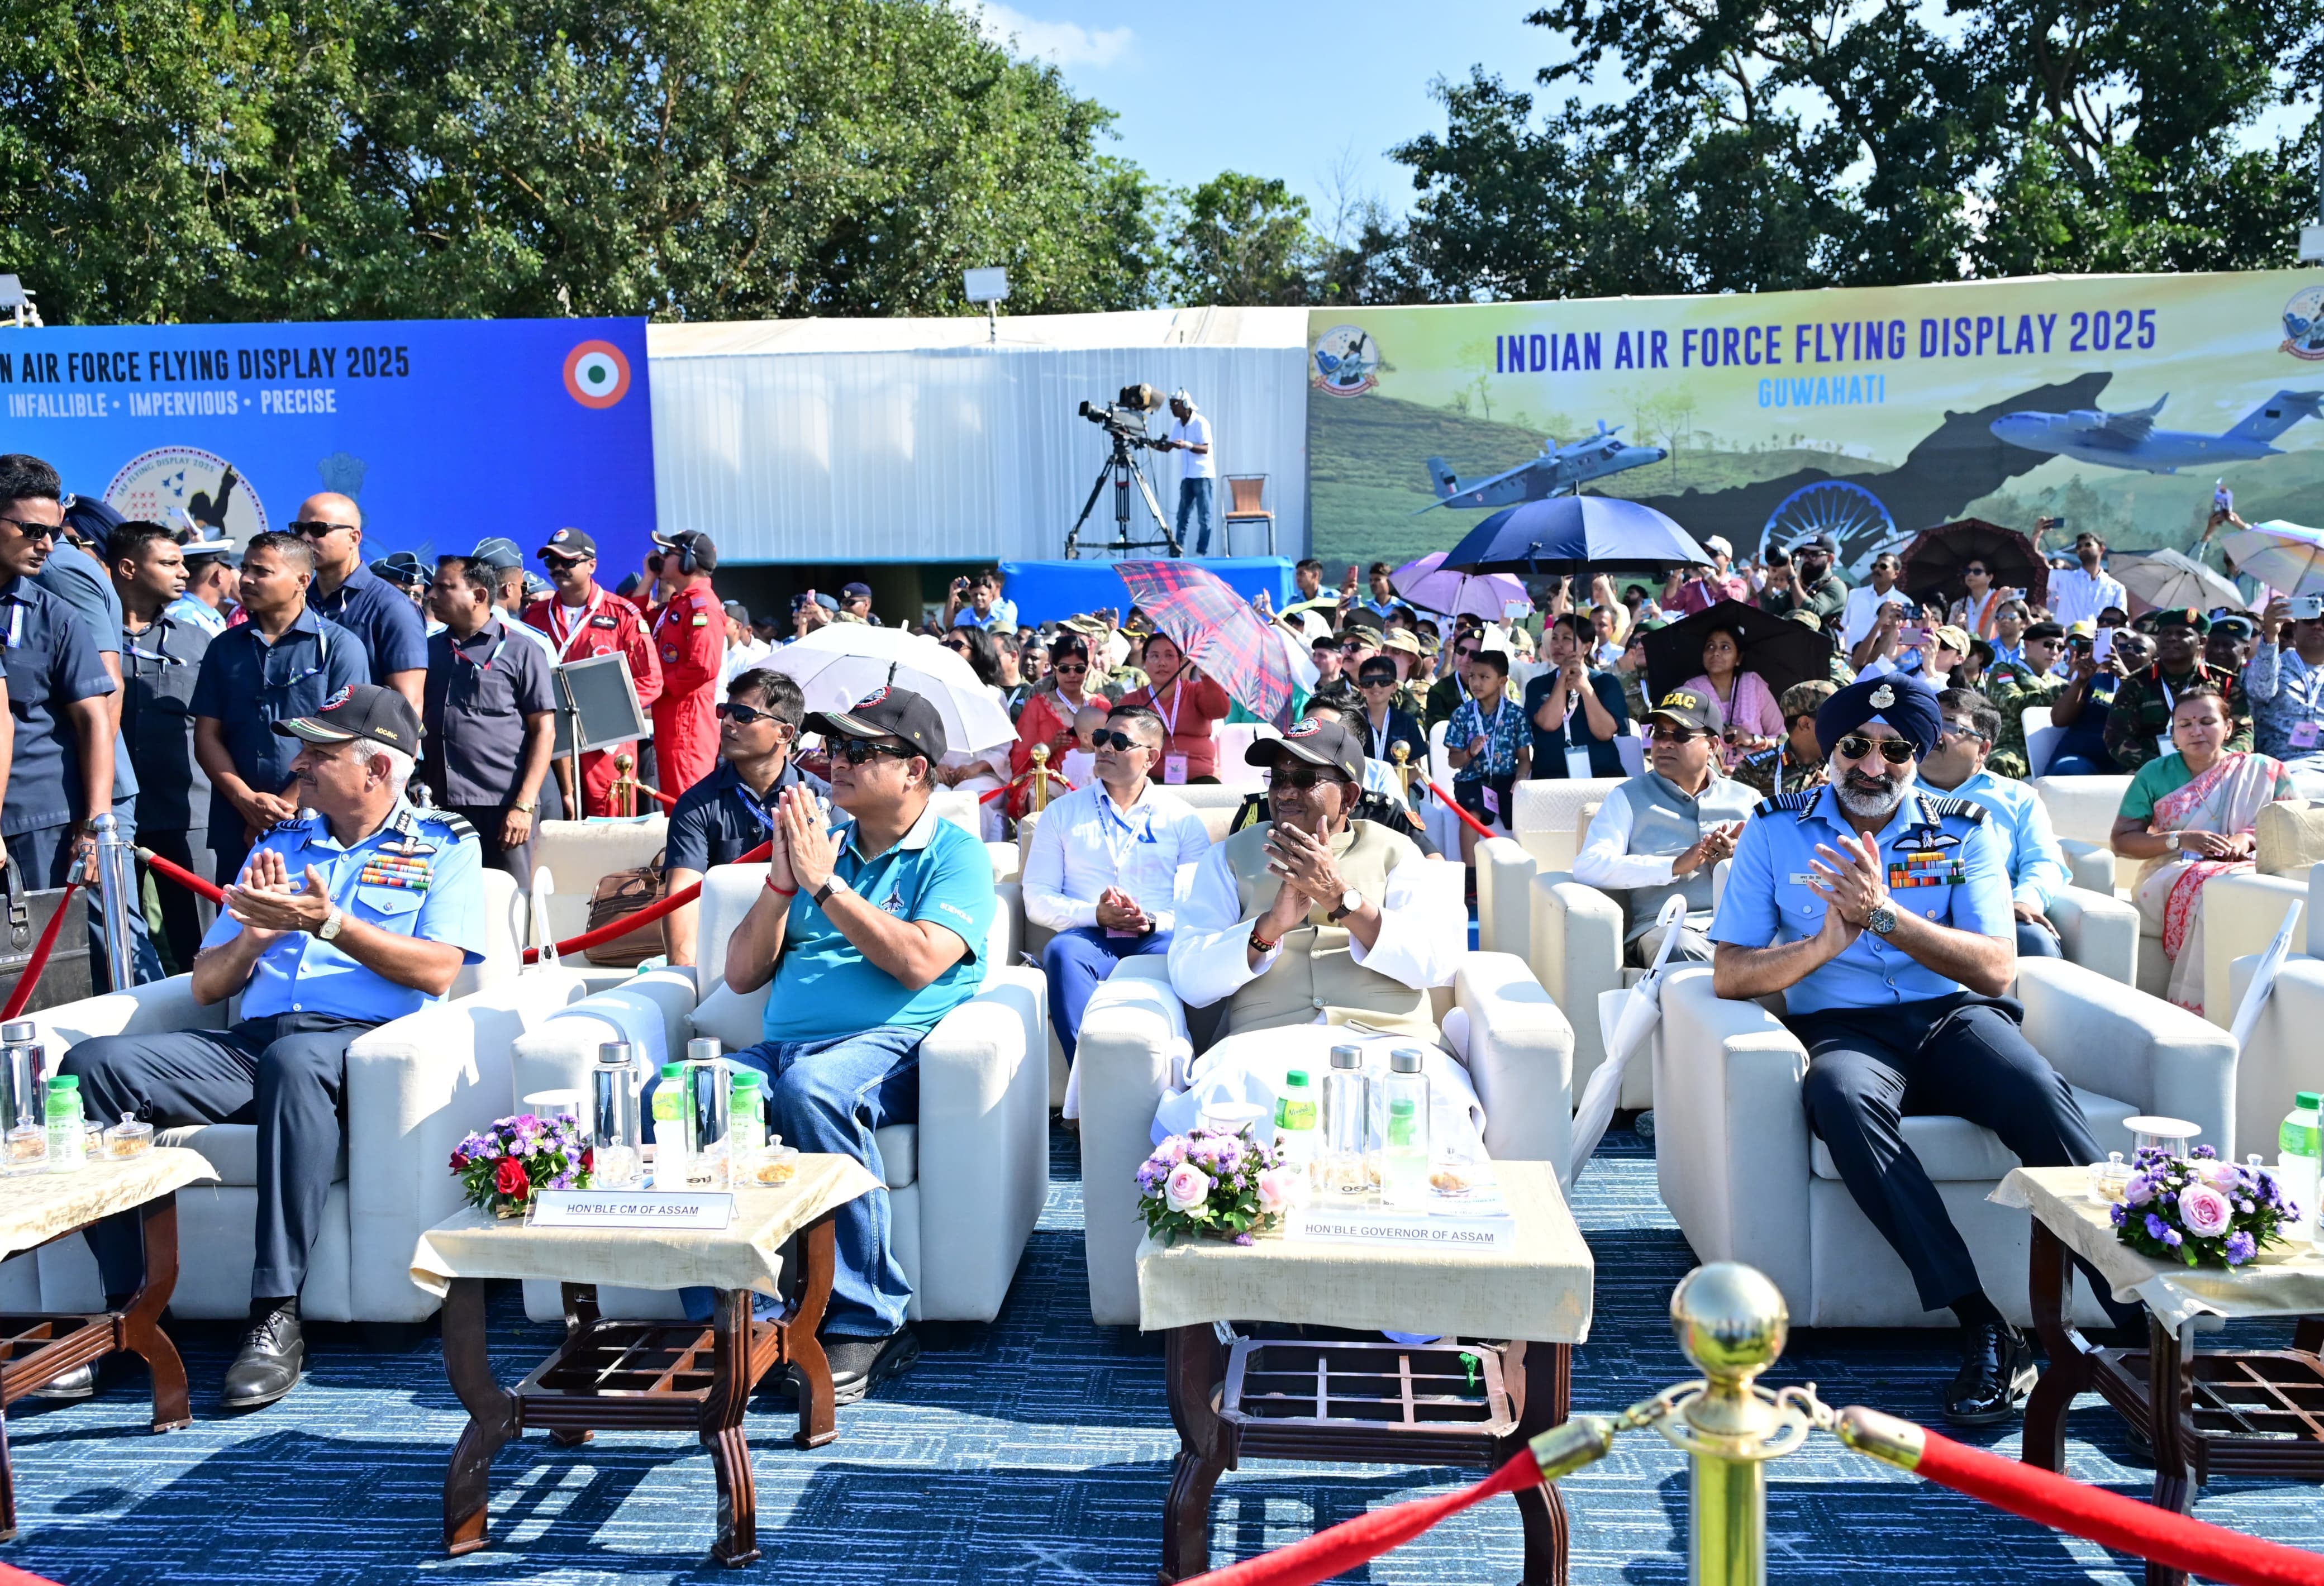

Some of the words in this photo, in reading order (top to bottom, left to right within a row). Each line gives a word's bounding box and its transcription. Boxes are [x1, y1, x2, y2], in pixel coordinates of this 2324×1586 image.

[1496, 332, 1601, 373] INDIAN
[1614, 330, 1669, 369] AIR
[1682, 325, 1782, 368] FORCE
[1795, 320, 1906, 363] FLYING
[1920, 313, 2058, 358] DISPLAY
[2069, 309, 2156, 352] 2025
[22, 353, 61, 383] AIR
[68, 351, 141, 383] FORCE
[149, 350, 229, 382] FLYING
[237, 347, 336, 380] DISPLAY
[346, 346, 409, 378] 2025
[8, 393, 108, 417] INFALLIBLE
[128, 390, 239, 417] IMPERVIOUS
[260, 388, 337, 415] PRECISE
[1758, 374, 1885, 408] GUWAHATI
[127, 464, 154, 484] FLYING
[156, 456, 190, 468] DISPLAY
[193, 459, 215, 473] 2025
[1660, 692, 1697, 710] EAC
[566, 1204, 617, 1213] HON'BLE
[620, 1205, 637, 1213] CM
[640, 1206, 656, 1214] OF
[658, 1206, 699, 1214] ASSAM
[1306, 1224, 1358, 1235] HON'BLE
[1361, 1226, 1429, 1239] GOVERNOR
[1432, 1230, 1449, 1240] OF
[1451, 1231, 1494, 1242] ASSAM
